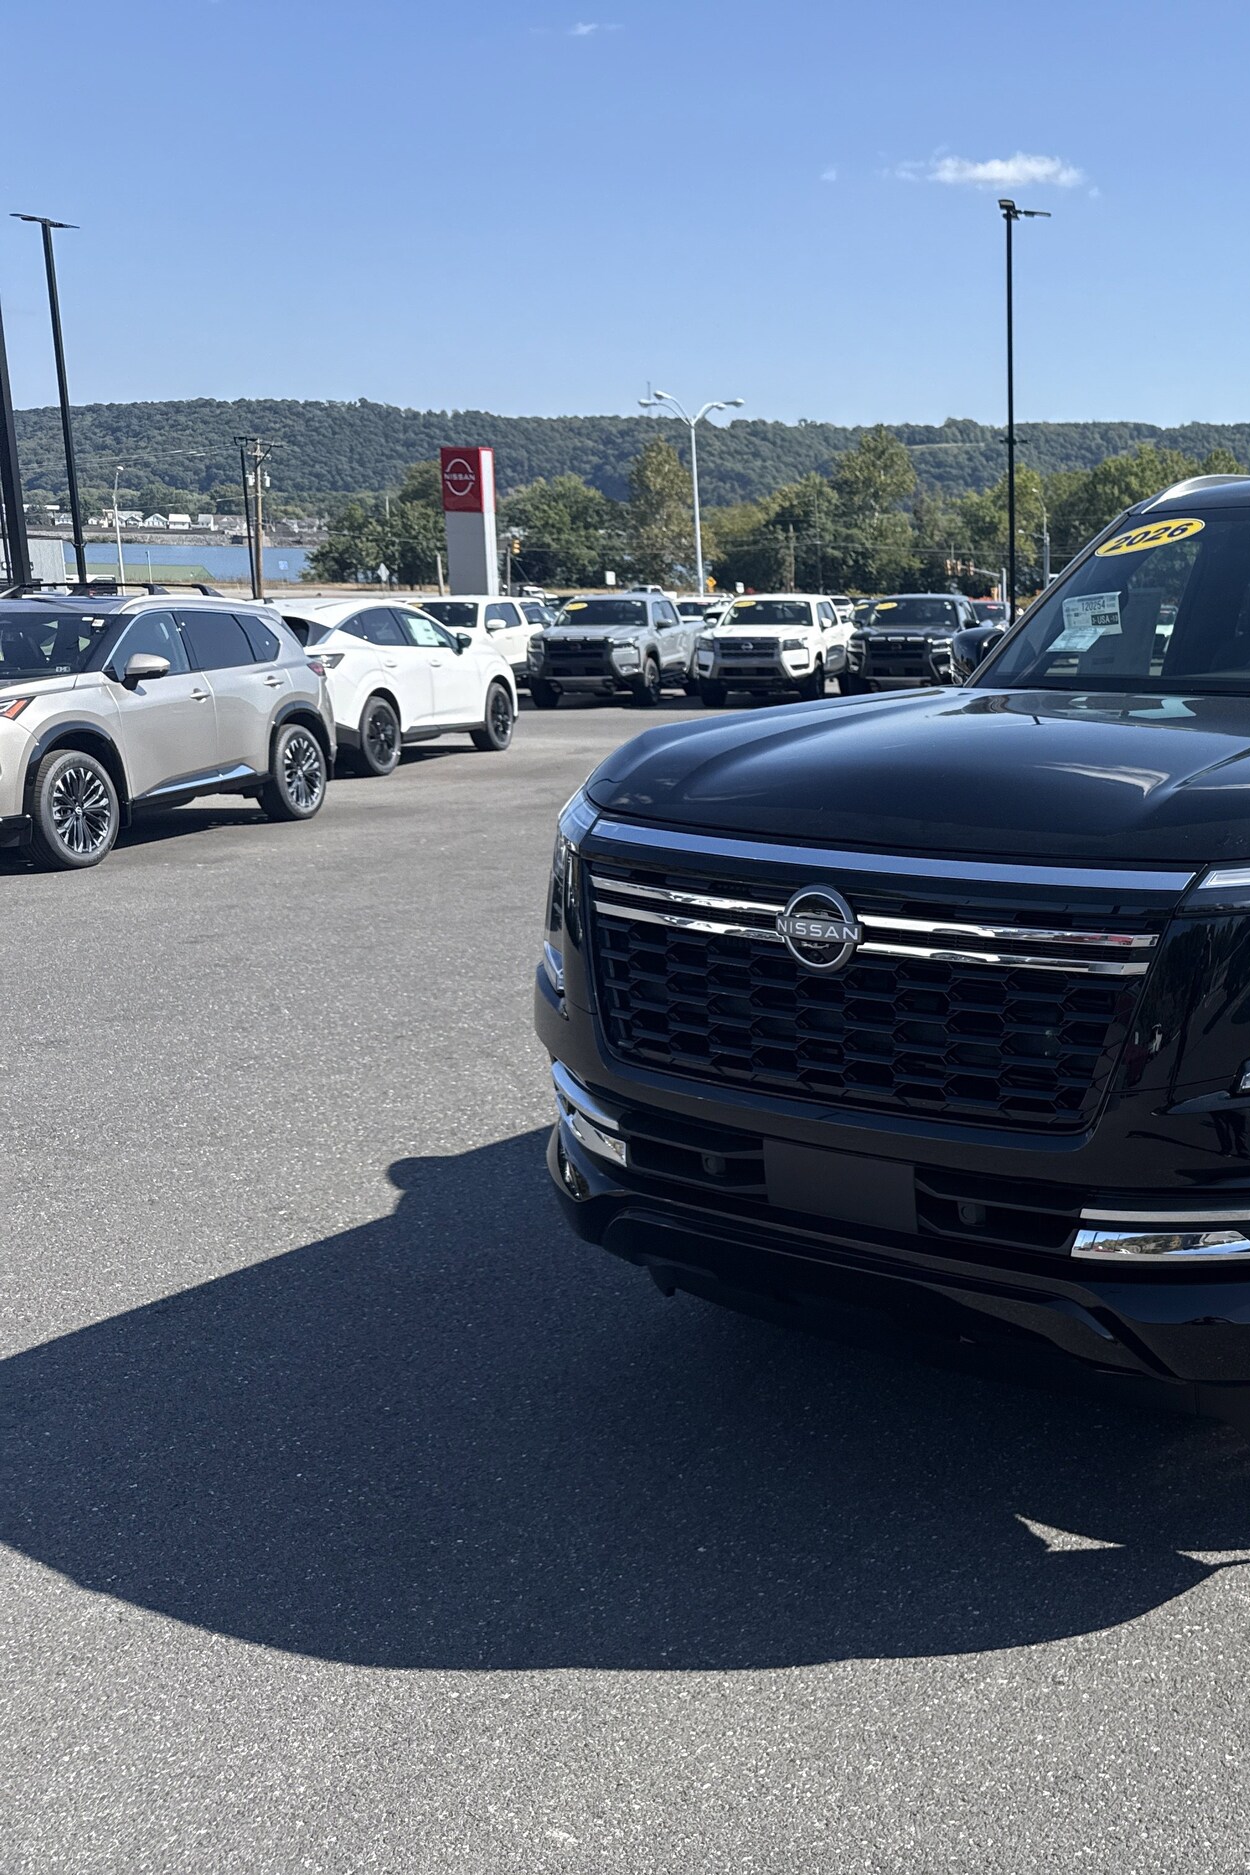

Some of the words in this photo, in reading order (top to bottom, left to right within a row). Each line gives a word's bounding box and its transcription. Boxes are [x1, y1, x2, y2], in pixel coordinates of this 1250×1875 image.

[443, 473, 476, 481] NISSAN
[1103, 522, 1194, 553] 2026
[777, 918, 858, 941] NISSAN
